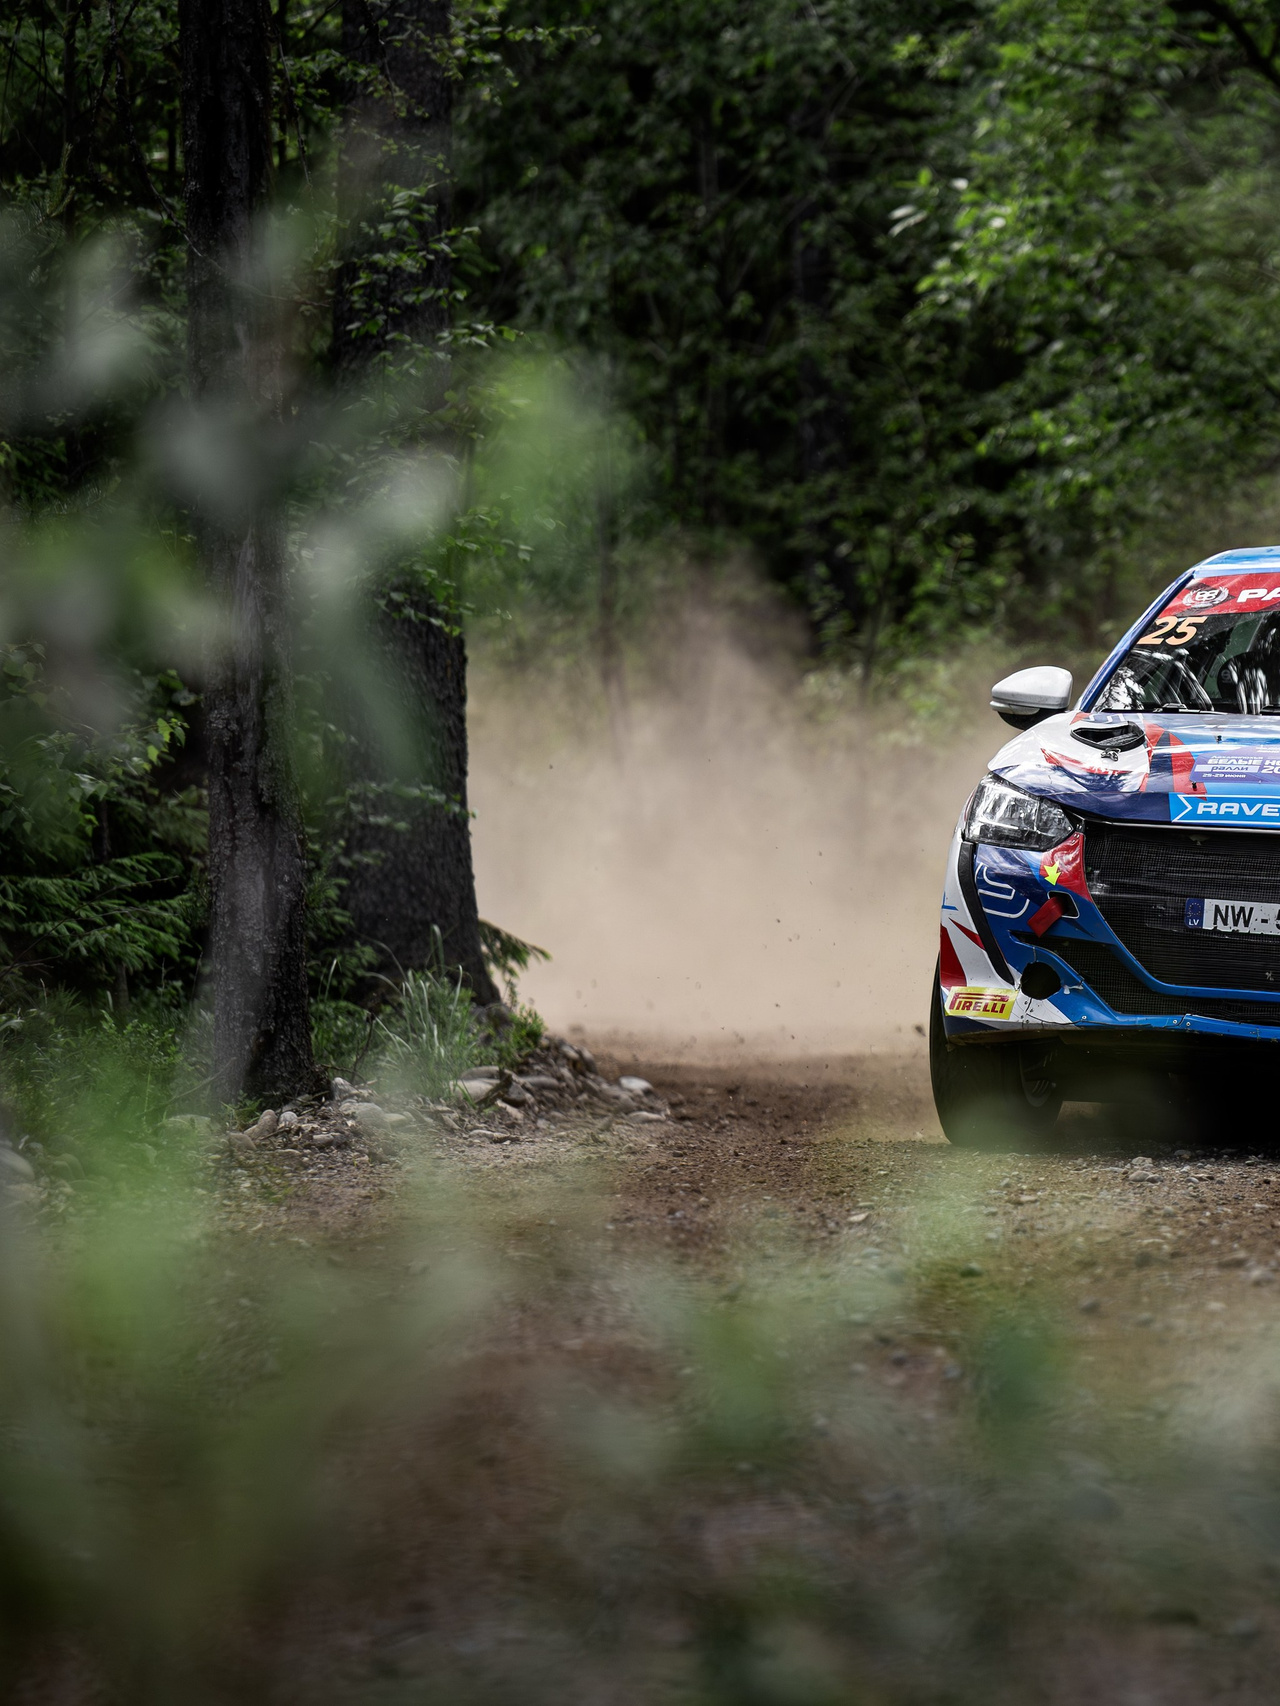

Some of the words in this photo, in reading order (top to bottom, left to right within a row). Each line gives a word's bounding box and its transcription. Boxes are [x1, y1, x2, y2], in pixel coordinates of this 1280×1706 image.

[1137, 615, 1208, 646] 25
[1207, 758, 1263, 766] БЕЛЫЕ
[1211, 765, 1249, 773] ралли
[1188, 918, 1200, 926] LV
[948, 992, 1010, 1014] PIRELLI
